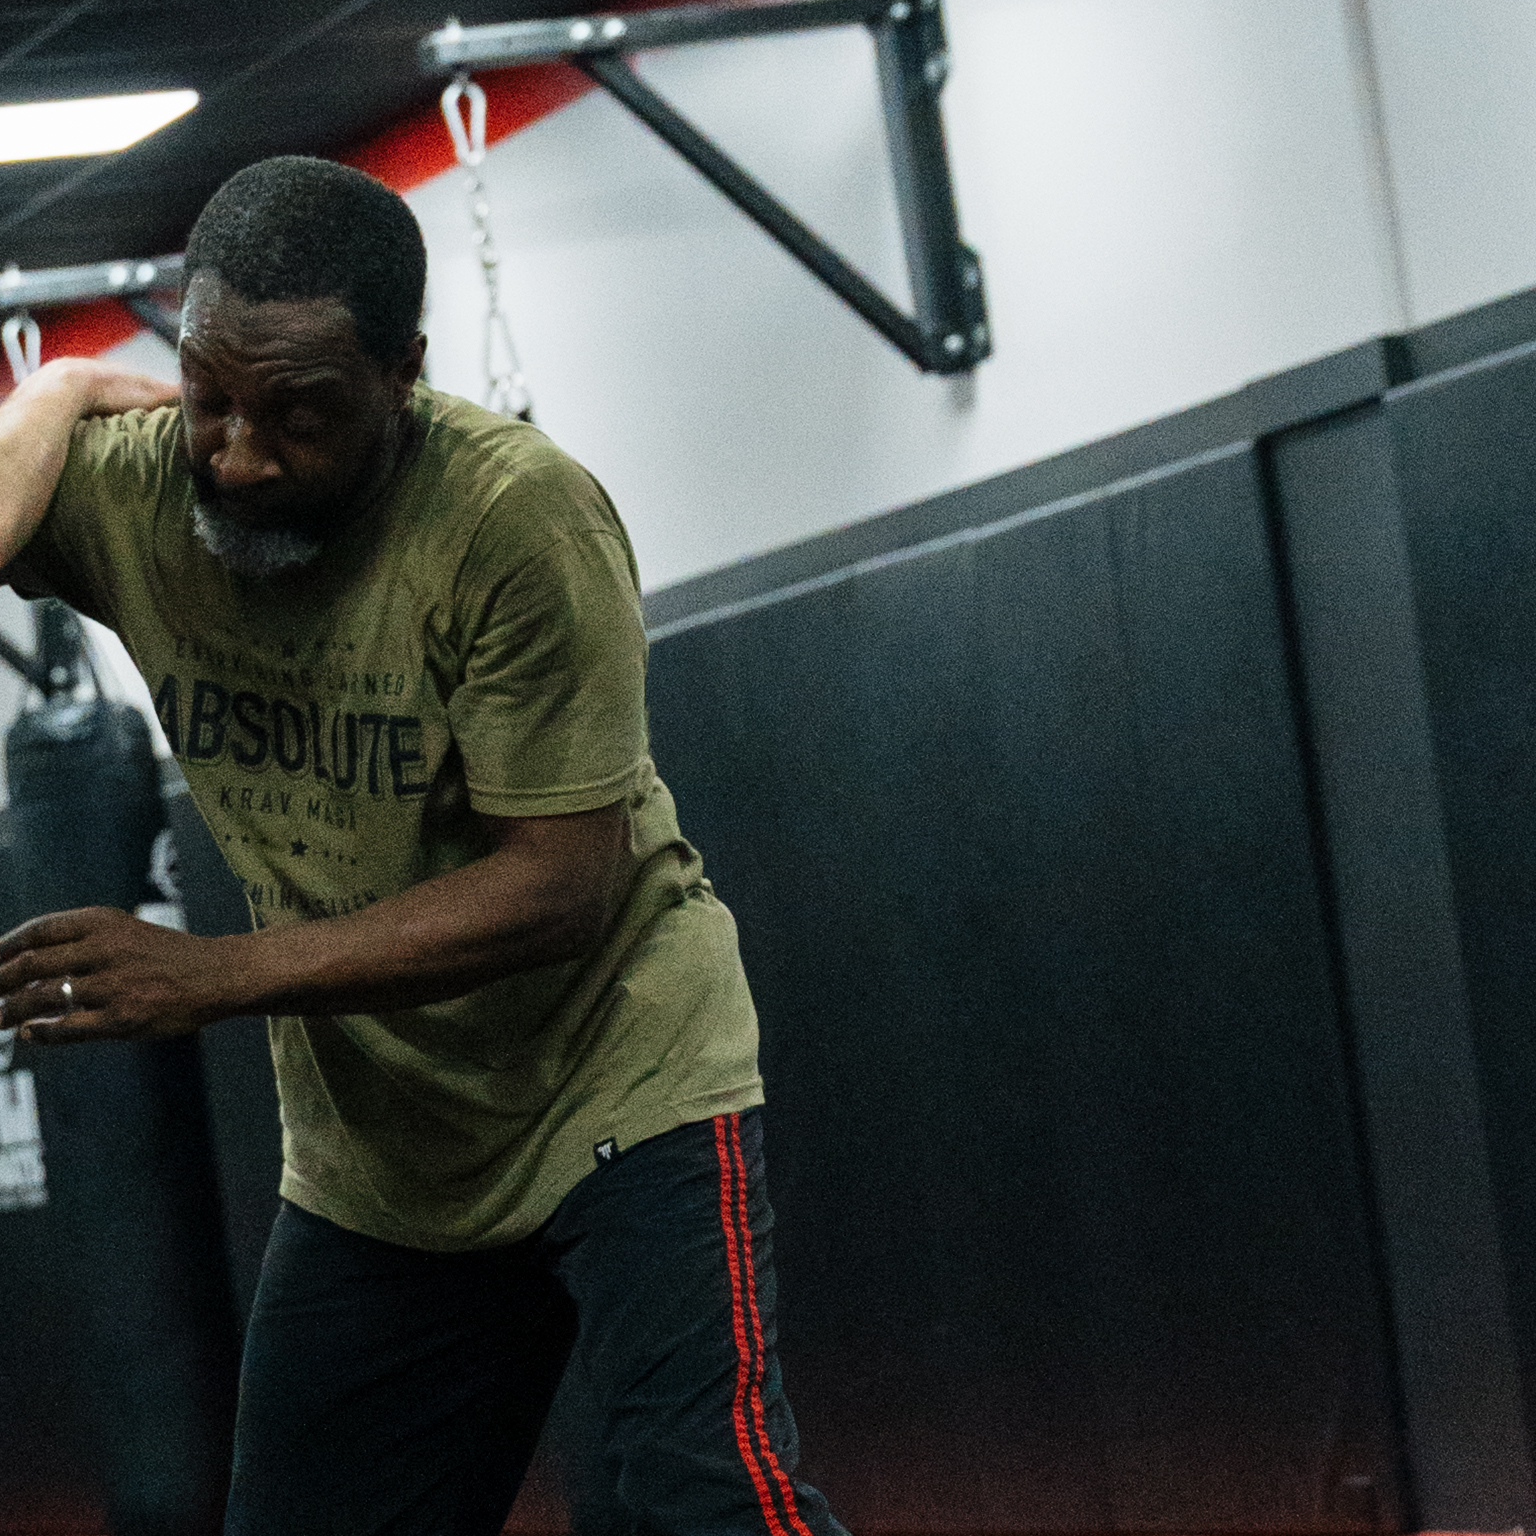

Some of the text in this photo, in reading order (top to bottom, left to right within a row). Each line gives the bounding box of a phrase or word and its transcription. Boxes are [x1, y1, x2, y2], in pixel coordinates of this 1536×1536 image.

[152, 674, 430, 796] ABSOLUTE
[219, 786, 357, 830] KRAV MAGA
